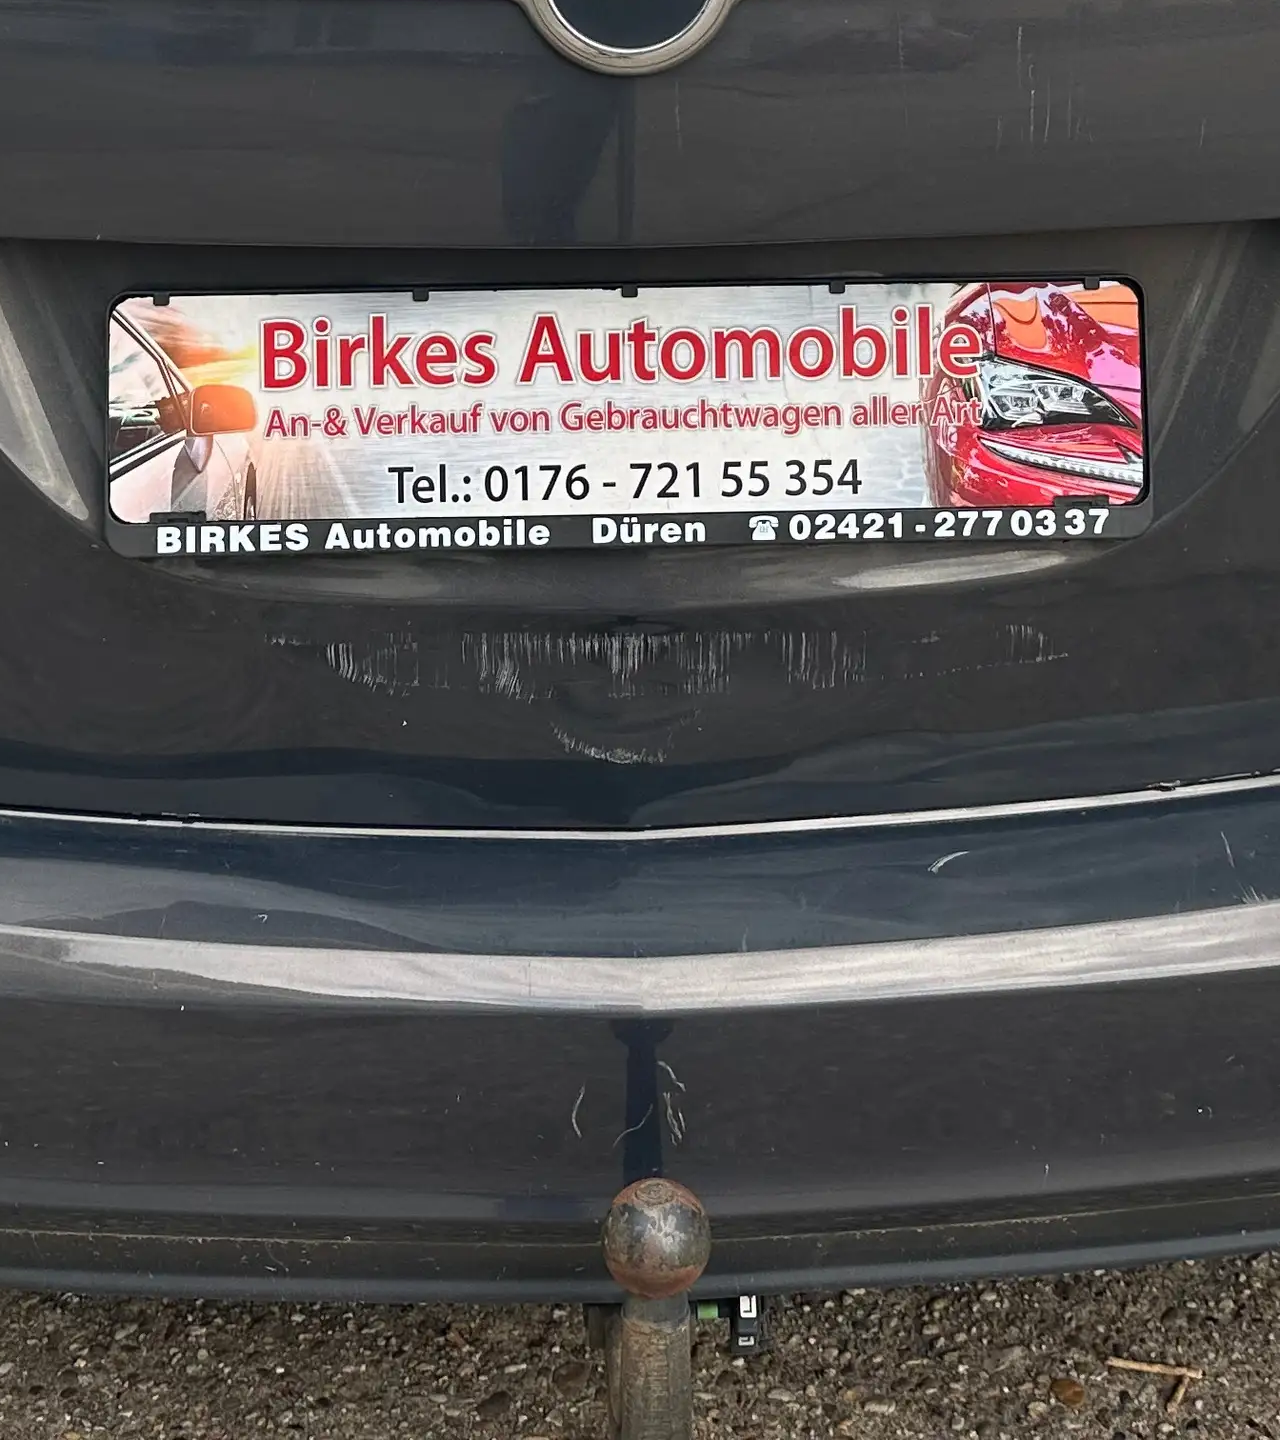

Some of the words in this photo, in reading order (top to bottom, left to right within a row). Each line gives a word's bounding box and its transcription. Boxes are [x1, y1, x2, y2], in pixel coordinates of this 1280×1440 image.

[261, 313, 498, 390] Birkes
[519, 307, 982, 386] Automobile
[356, 402, 485, 436] Verkauf
[490, 407, 550, 433] von
[560, 400, 843, 436] Gebrauchtwagen
[852, 396, 922, 428] aller
[933, 397, 983, 427] Art
[388, 465, 471, 504] Tel.:
[484, 464, 589, 501] 0176
[630, 461, 701, 498] 721
[720, 460, 771, 497] 55
[785, 459, 863, 495] 354
[156, 523, 310, 554] BIRKES
[325, 519, 550, 550] Automobile
[591, 517, 706, 544] Düren
[789, 513, 902, 541] 02421
